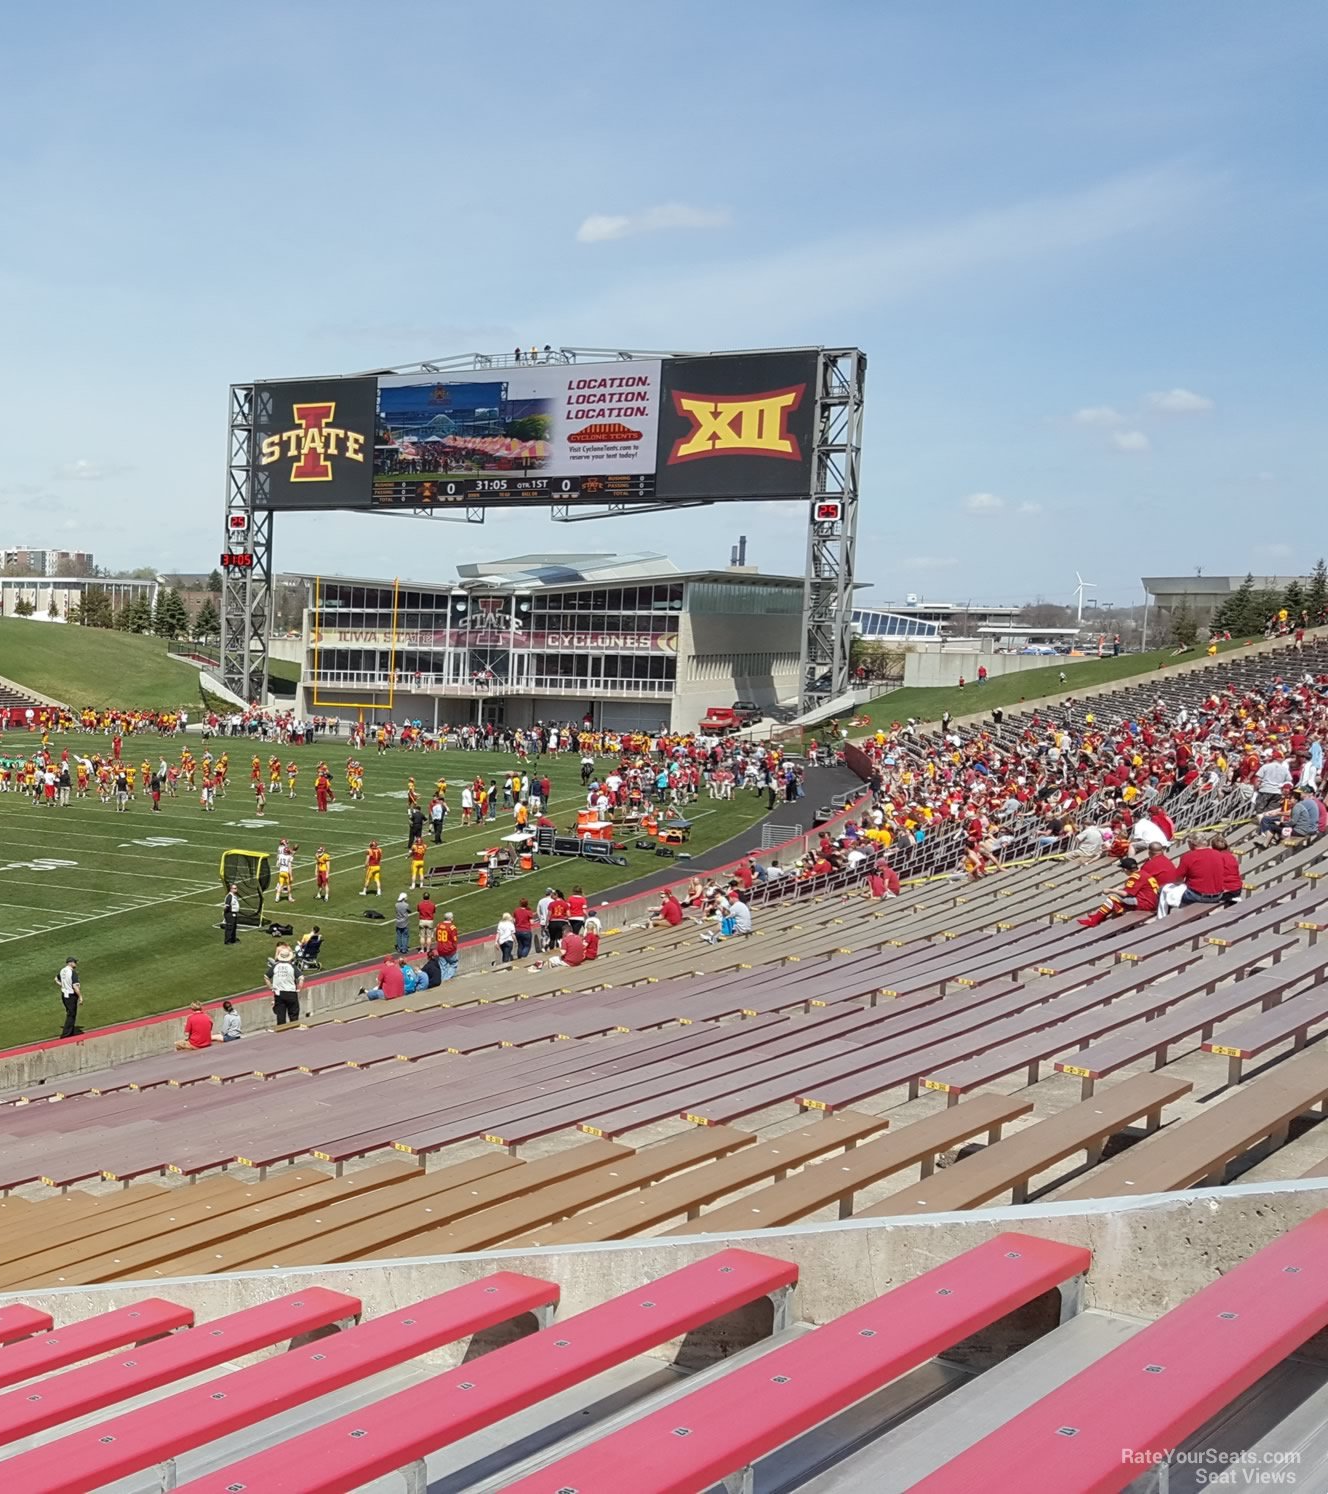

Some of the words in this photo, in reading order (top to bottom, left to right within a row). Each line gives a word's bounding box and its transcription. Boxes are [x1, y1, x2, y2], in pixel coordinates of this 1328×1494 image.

[567, 376, 651, 390] LOCATION.
[566, 391, 650, 405] LOCATION.
[565, 406, 649, 420] LOCATION.
[677, 392, 797, 457] XII
[261, 427, 365, 466] STATE
[446, 483, 456, 494] 0
[475, 480, 508, 490] 31:05
[531, 479, 548, 488] 1ST
[561, 480, 571, 491] 0
[819, 506, 837, 518] 25
[231, 517, 244, 528] 25
[223, 554, 251, 566] 31:05
[458, 613, 523, 635] STATE
[547, 634, 651, 647] CYCLONES
